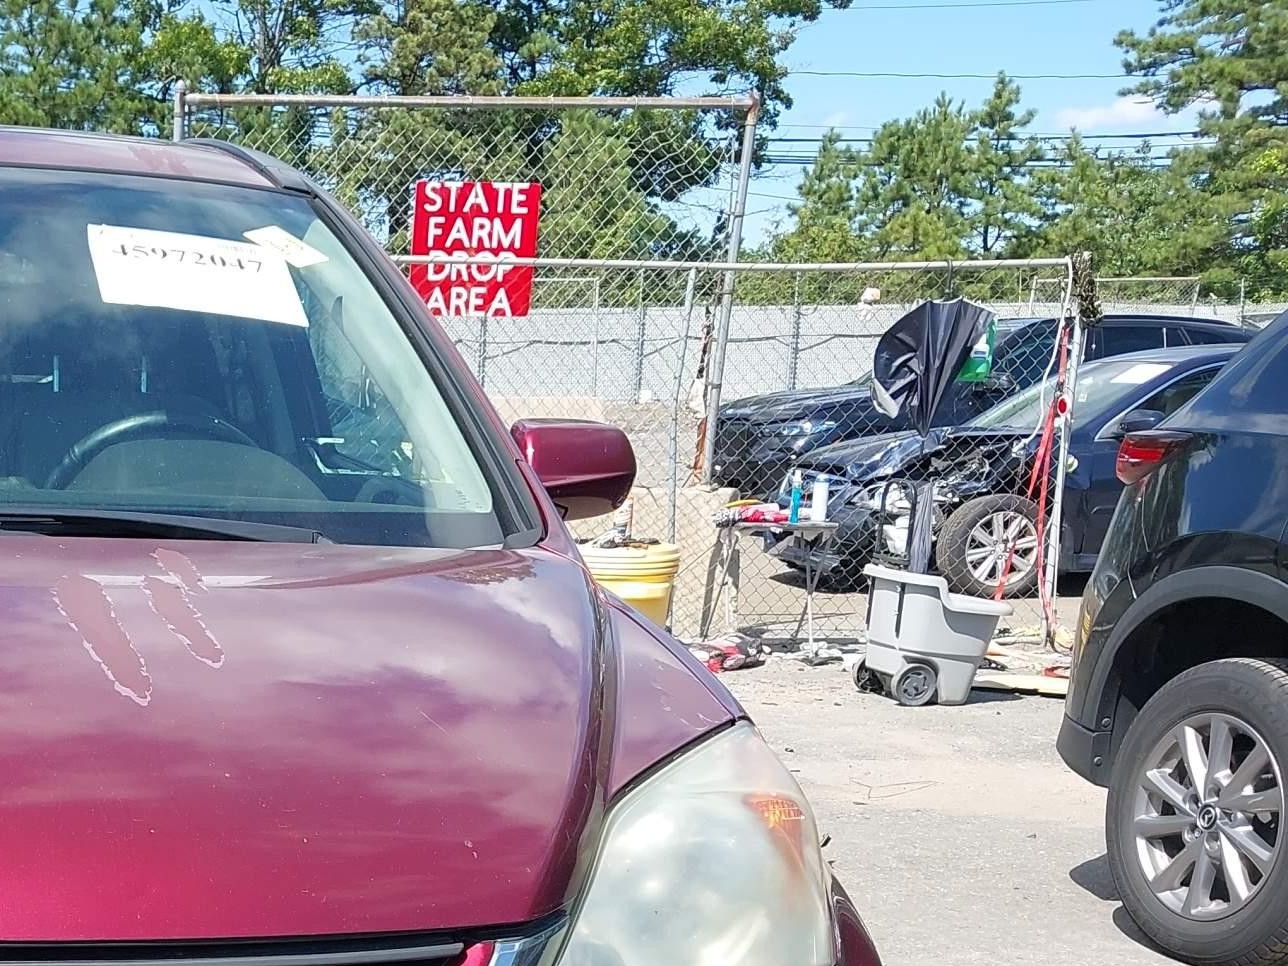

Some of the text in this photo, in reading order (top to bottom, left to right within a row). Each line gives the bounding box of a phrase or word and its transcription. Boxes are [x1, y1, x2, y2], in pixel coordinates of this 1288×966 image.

[423, 182, 530, 214] STATE
[427, 216, 523, 249] FARM
[427, 250, 517, 282] DROP
[425, 286, 513, 318] AREA
